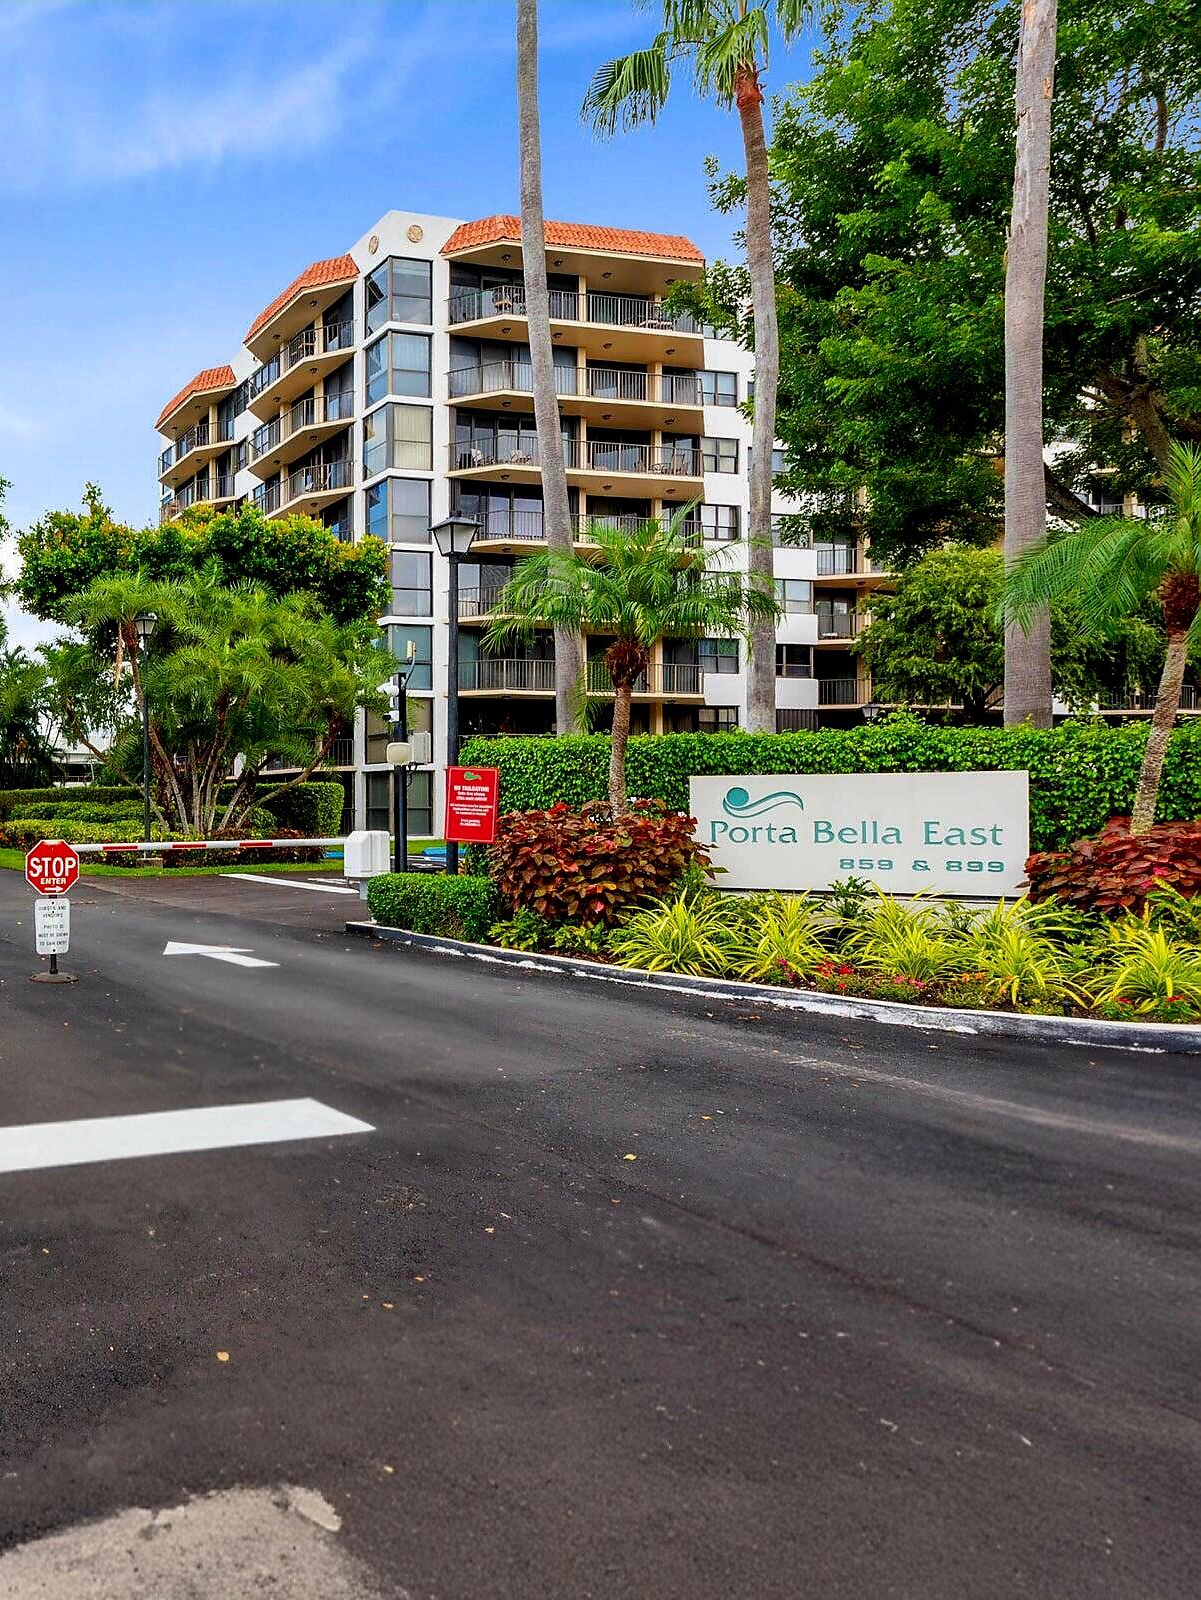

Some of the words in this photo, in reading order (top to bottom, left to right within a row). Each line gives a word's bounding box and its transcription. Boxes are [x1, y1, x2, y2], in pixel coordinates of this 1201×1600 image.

[710, 820, 798, 844] Porta
[813, 820, 902, 845] Bella
[924, 821, 1004, 846] East
[29, 857, 76, 877] STOP
[839, 858, 894, 871] 859
[911, 860, 931, 872] &
[946, 860, 1005, 873] 899
[40, 877, 66, 885] ENTER
